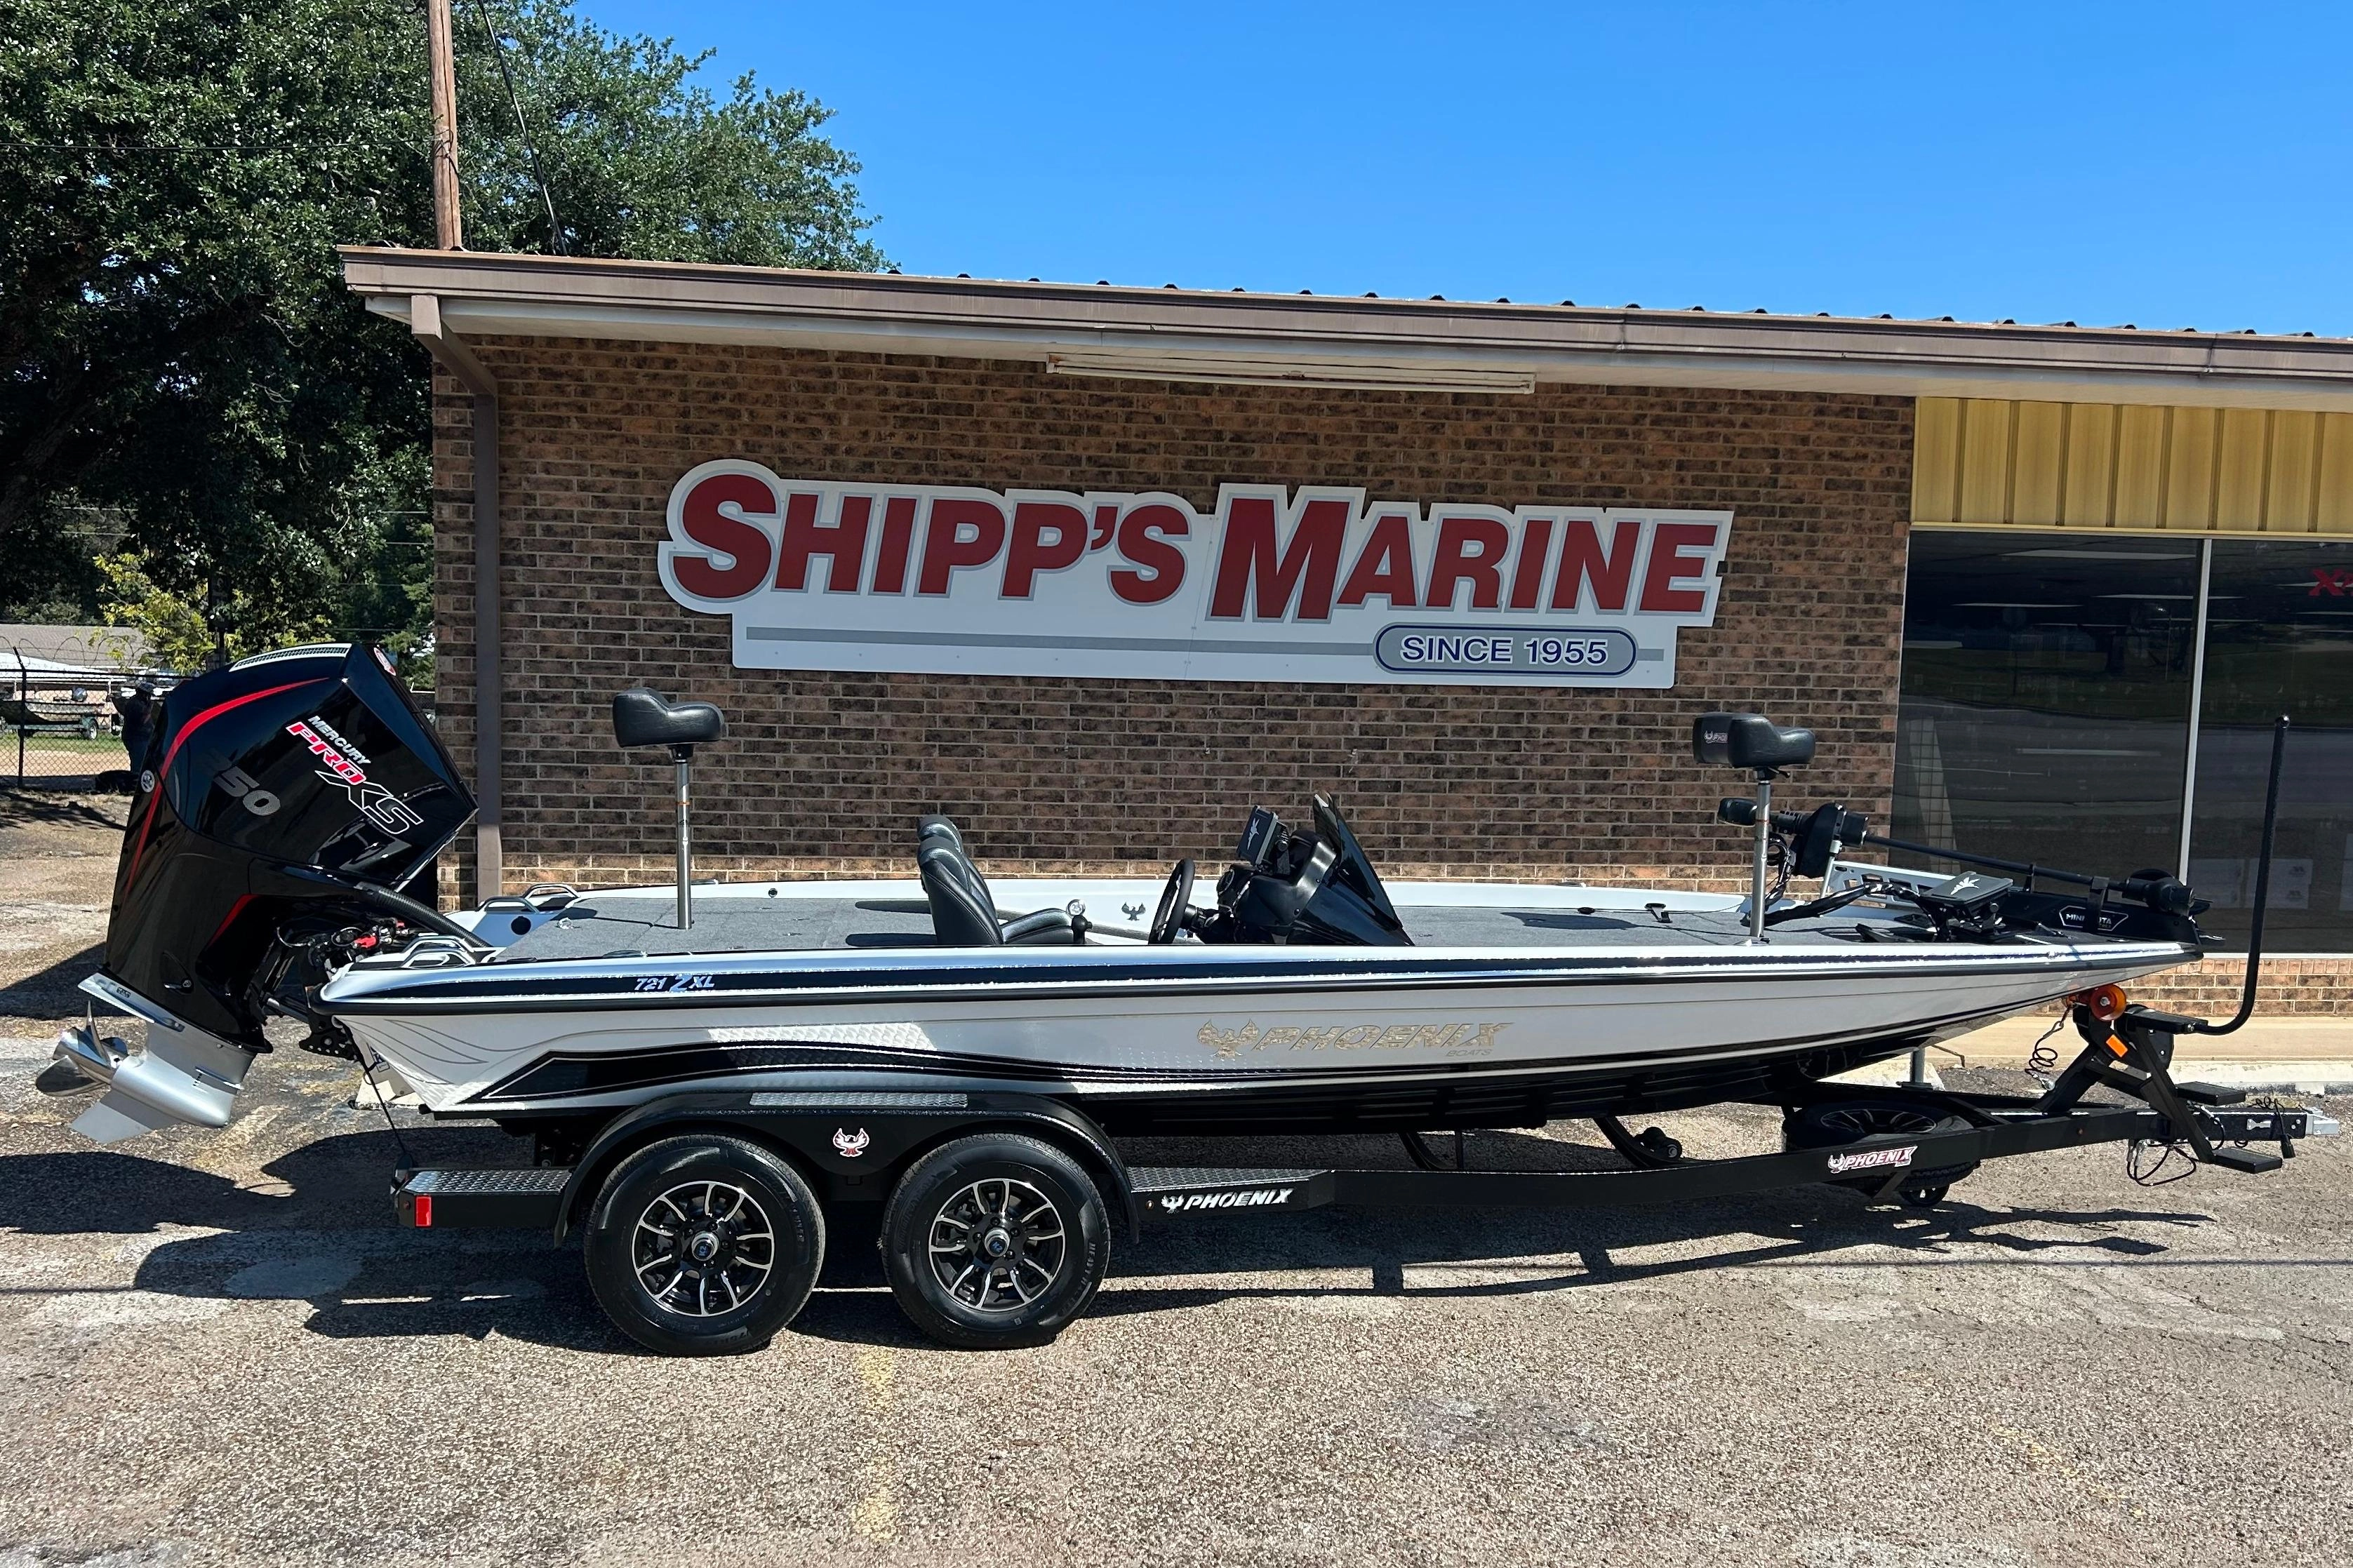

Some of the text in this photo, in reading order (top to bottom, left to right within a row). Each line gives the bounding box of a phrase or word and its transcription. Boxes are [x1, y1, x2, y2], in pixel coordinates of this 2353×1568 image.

[672, 473, 1719, 619] SHIPP'S MARINE
[1401, 635, 1608, 666] SINCE 1955
[308, 716, 371, 764] MERCURY
[286, 721, 424, 834] PRO XS
[634, 977, 667, 991] 721
[1251, 1022, 1515, 1051] PHOENIX
[1446, 1049, 1492, 1057] BOATS
[1843, 1148, 1913, 1169] PHOENIX
[1183, 1188, 1295, 1211] PHOENIX
